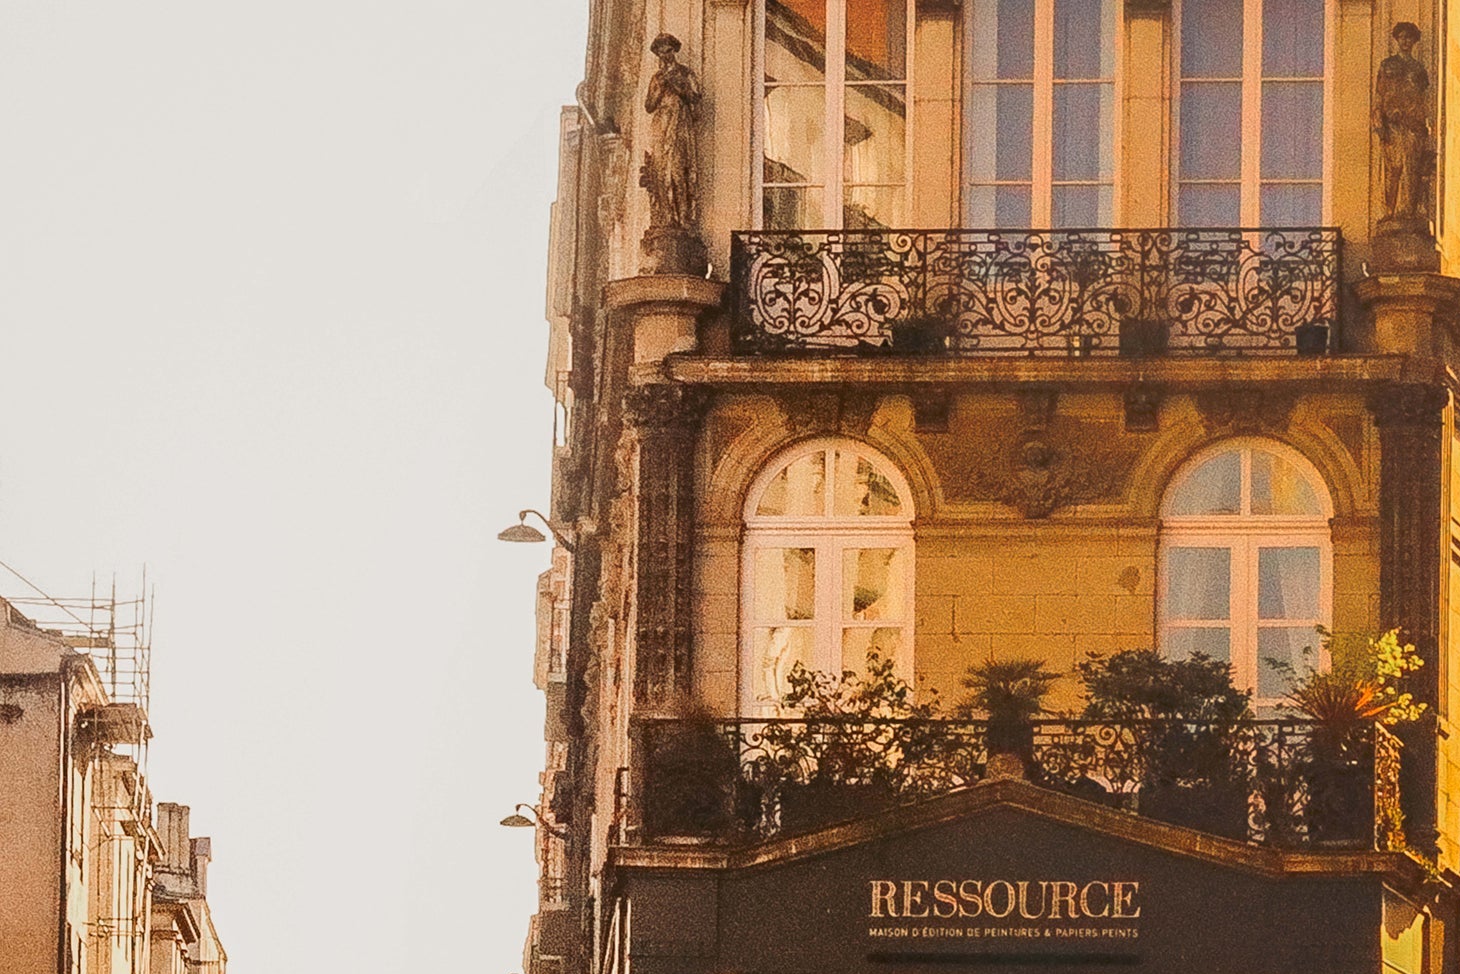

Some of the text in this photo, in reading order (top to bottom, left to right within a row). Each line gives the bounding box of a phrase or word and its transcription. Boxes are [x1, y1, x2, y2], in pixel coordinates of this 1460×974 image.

[868, 879, 1142, 919] RESSOURCE
[869, 927, 909, 938] MAISON
[966, 927, 981, 938] DE
[984, 927, 1041, 938] PEINTURES
[1044, 928, 1051, 938] &
[1055, 927, 1099, 938] PAPIERS
[1101, 927, 1139, 938] PEINTS
